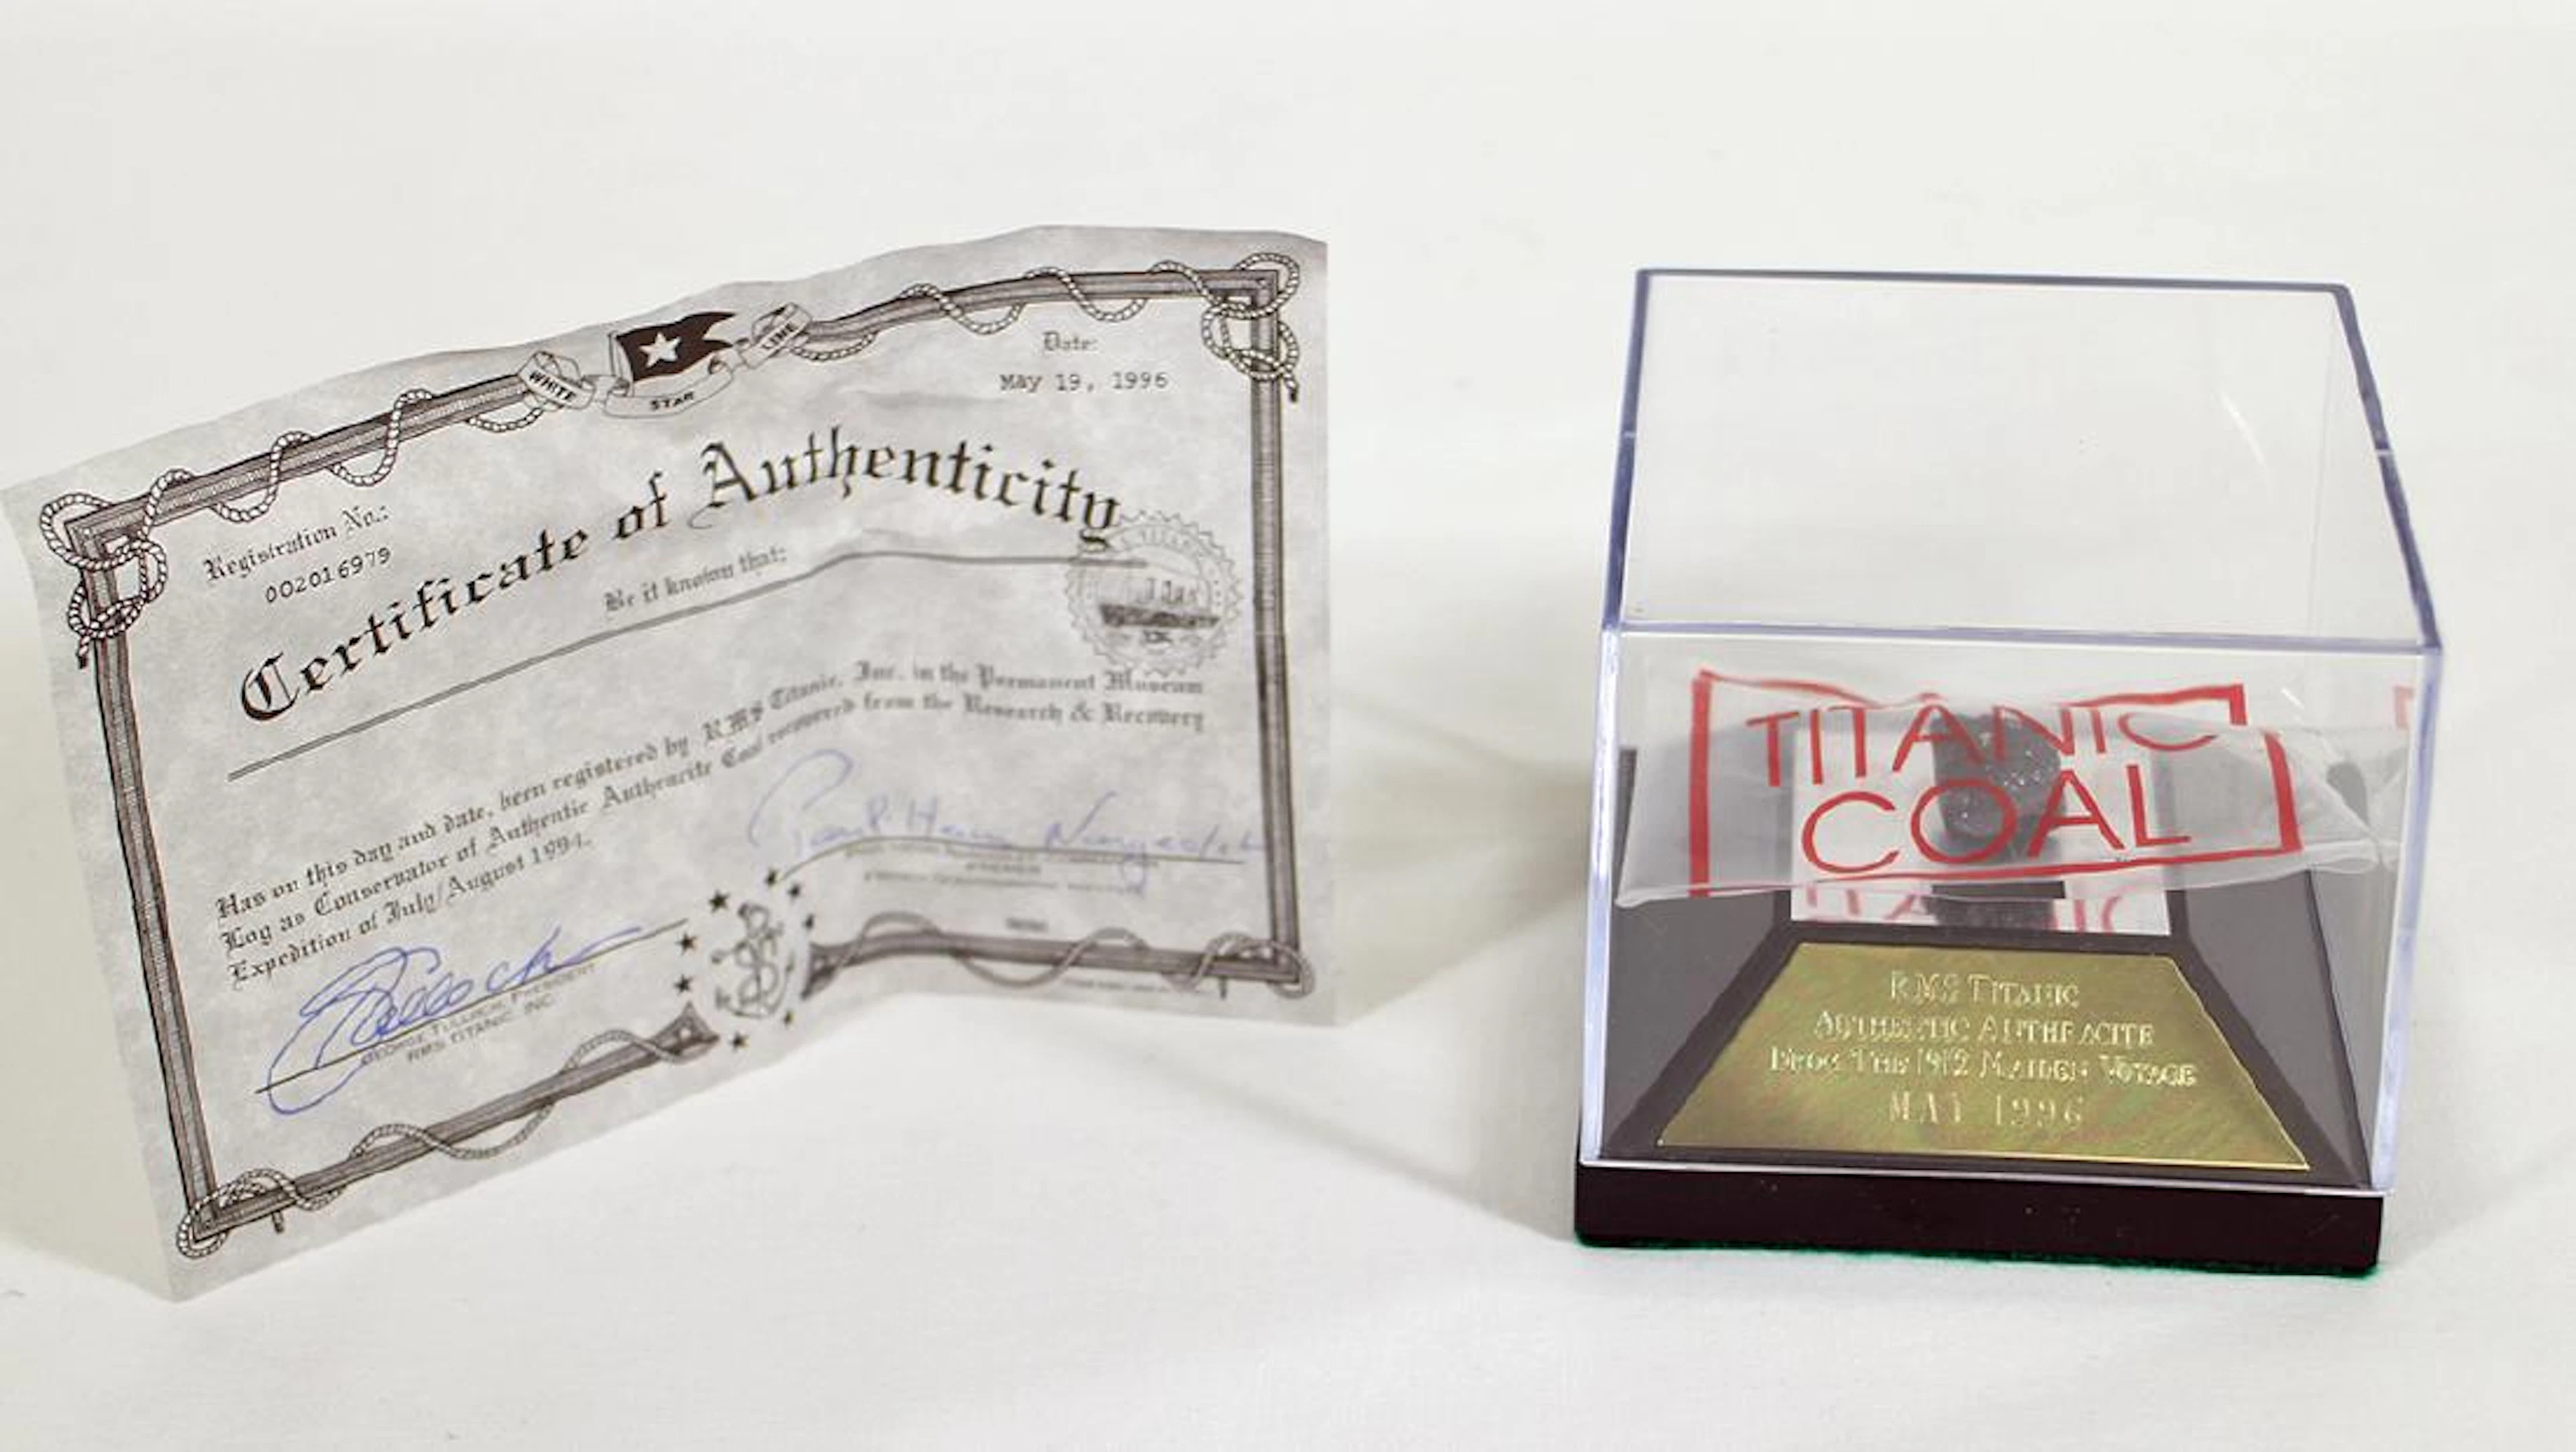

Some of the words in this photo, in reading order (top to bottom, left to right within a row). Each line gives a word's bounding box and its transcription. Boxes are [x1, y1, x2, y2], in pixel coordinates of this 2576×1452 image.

[760, 322, 796, 350] LINE
[528, 371, 576, 404] WHITE
[650, 391, 695, 411] STAR
[999, 373, 1041, 393] May
[1057, 373, 1095, 392] 19,
[1112, 372, 1169, 390] 1996
[202, 522, 338, 584] Registration
[240, 527, 589, 721] Certificate
[612, 471, 669, 540] of
[686, 424, 1124, 554] Authenticity
[264, 547, 391, 604] 002016979
[641, 581, 659, 603] it
[1746, 703, 2216, 788] TITANIC
[215, 889, 272, 920] Has
[272, 878, 299, 897] on
[306, 858, 348, 888] this
[352, 843, 392, 870] day
[398, 821, 437, 851] and
[500, 780, 547, 811] been
[665, 735, 690, 758] by
[940, 660, 969, 683] the
[1801, 763, 2190, 872] COAL
[220, 924, 272, 955] Log
[279, 913, 306, 932] as
[313, 858, 448, 917] Conservator
[456, 837, 478, 863] of
[484, 800, 589, 852] Authentic
[227, 931, 352, 992] Expedition
[358, 912, 378, 935] of
